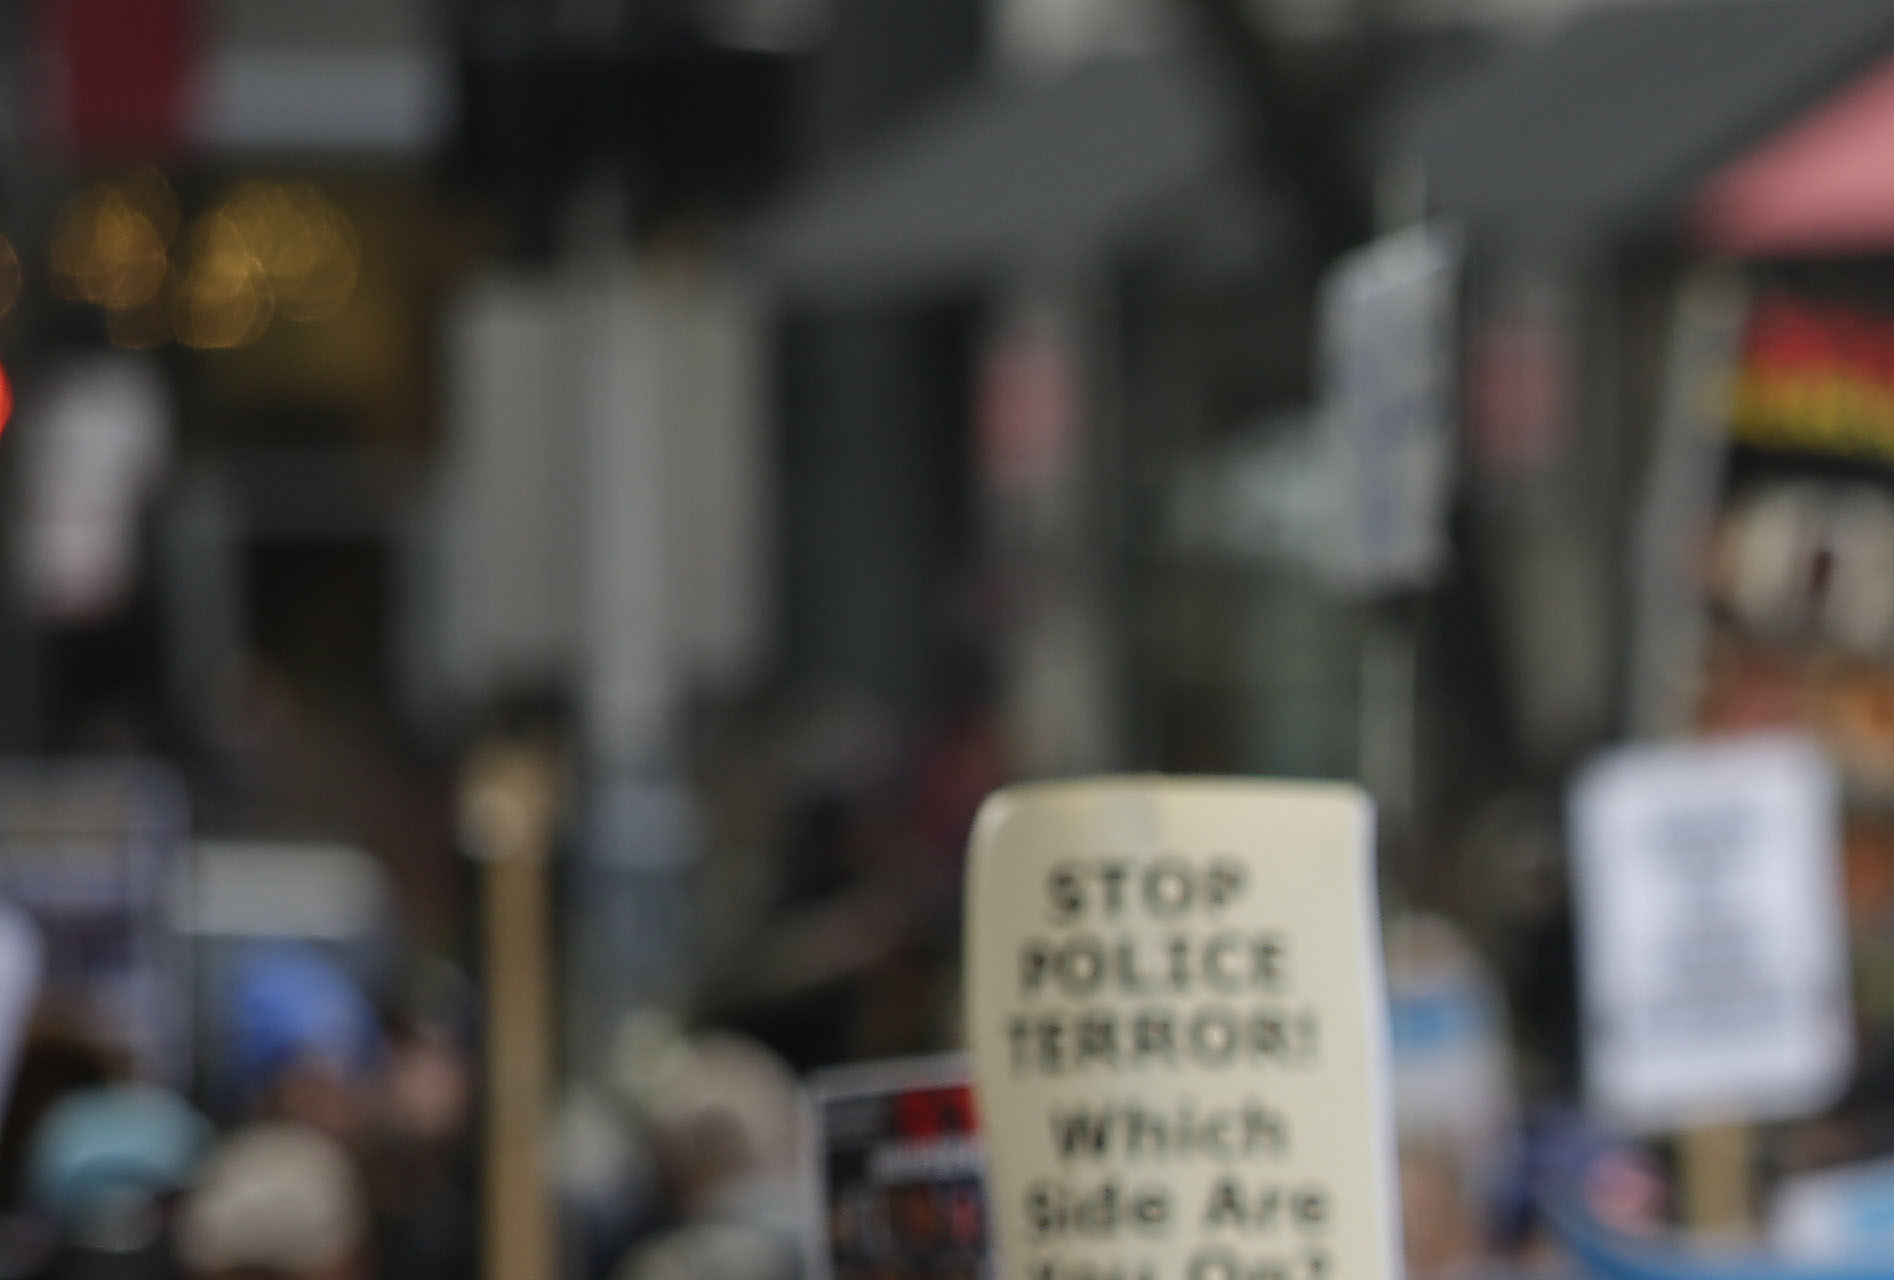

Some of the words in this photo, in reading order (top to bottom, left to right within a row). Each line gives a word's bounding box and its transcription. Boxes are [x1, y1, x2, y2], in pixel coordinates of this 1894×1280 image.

[1048, 857, 1247, 921] STOP
[1020, 934, 1292, 998] POLICE
[1008, 1008, 1319, 1074] TERROR!
[1051, 1092, 1286, 1164] Which
[1024, 1181, 1171, 1242] Side
[1202, 1181, 1332, 1237] Are
